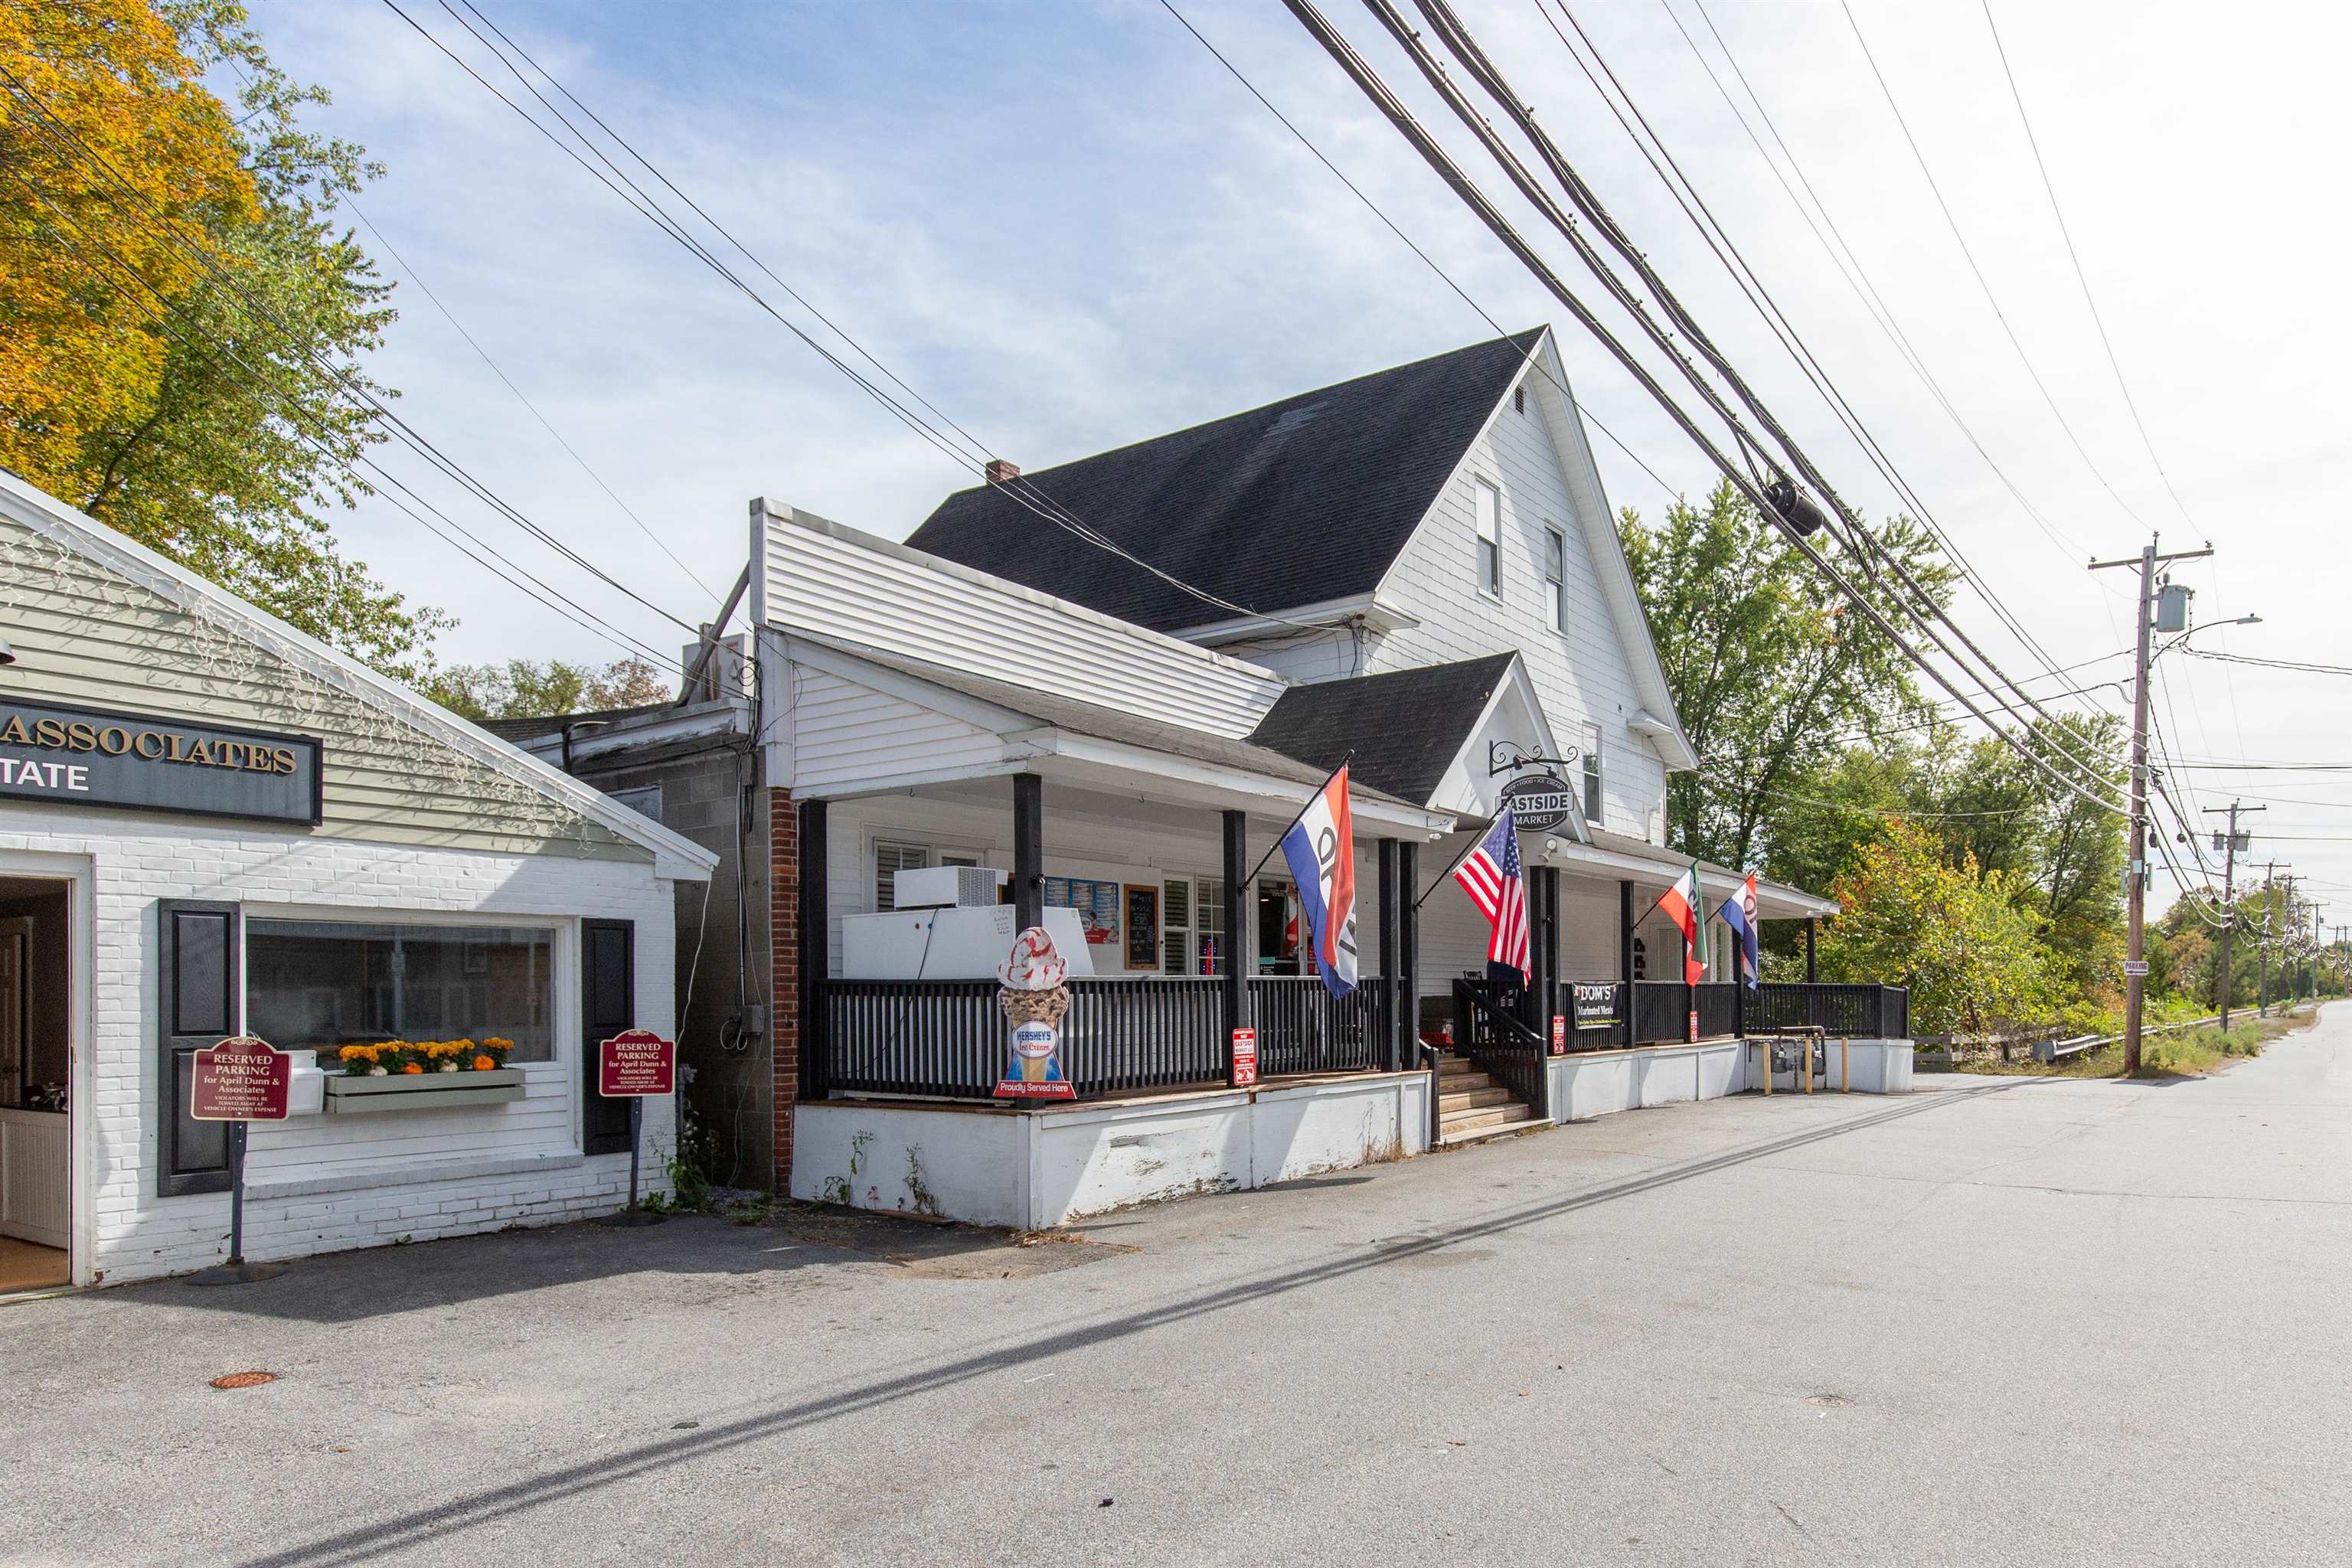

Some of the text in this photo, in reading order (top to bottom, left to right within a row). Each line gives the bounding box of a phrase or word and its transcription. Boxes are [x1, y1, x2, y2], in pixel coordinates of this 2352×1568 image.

[0, 714, 298, 774] ASSOCIATES
[1580, 985, 1611, 1001] DOM'S
[1017, 1031, 1051, 1041] HERSHEY'S
[1019, 1042, 1050, 1051] Ice Cream
[214, 1054, 273, 1065] RESERVED
[620, 1060, 638, 1069] April
[216, 1065, 270, 1076] PARKING
[220, 1076, 242, 1086] April
[218, 1085, 265, 1093] Associates
[1000, 1083, 1069, 1093] Proudly Served Here
